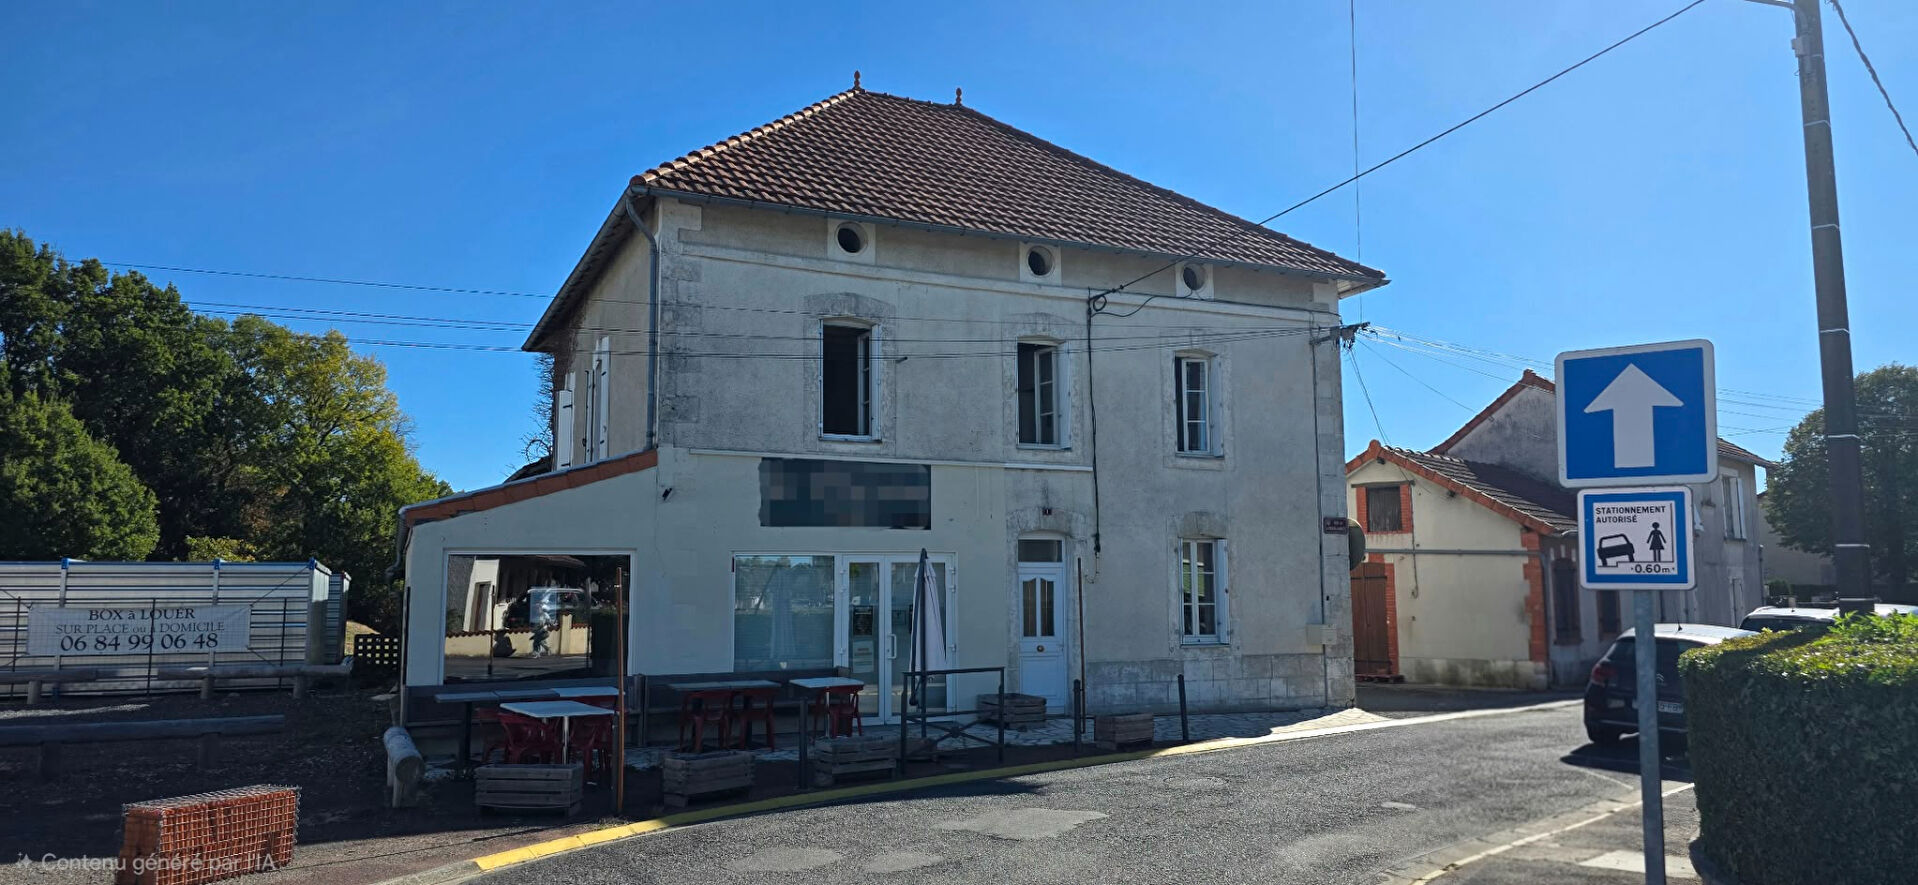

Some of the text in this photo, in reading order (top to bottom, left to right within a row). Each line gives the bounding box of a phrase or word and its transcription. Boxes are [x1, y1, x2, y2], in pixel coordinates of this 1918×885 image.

[1595, 505, 1666, 514] STATIONNEMENT
[1595, 515, 1638, 523] AUTORISÉ
[88, 608, 195, 621] BOX à LOUER
[56, 624, 83, 635] SUR
[87, 623, 129, 634] PLACE
[160, 622, 225, 633] DOMICILE
[60, 632, 218, 652] 06 84 99 06 48
